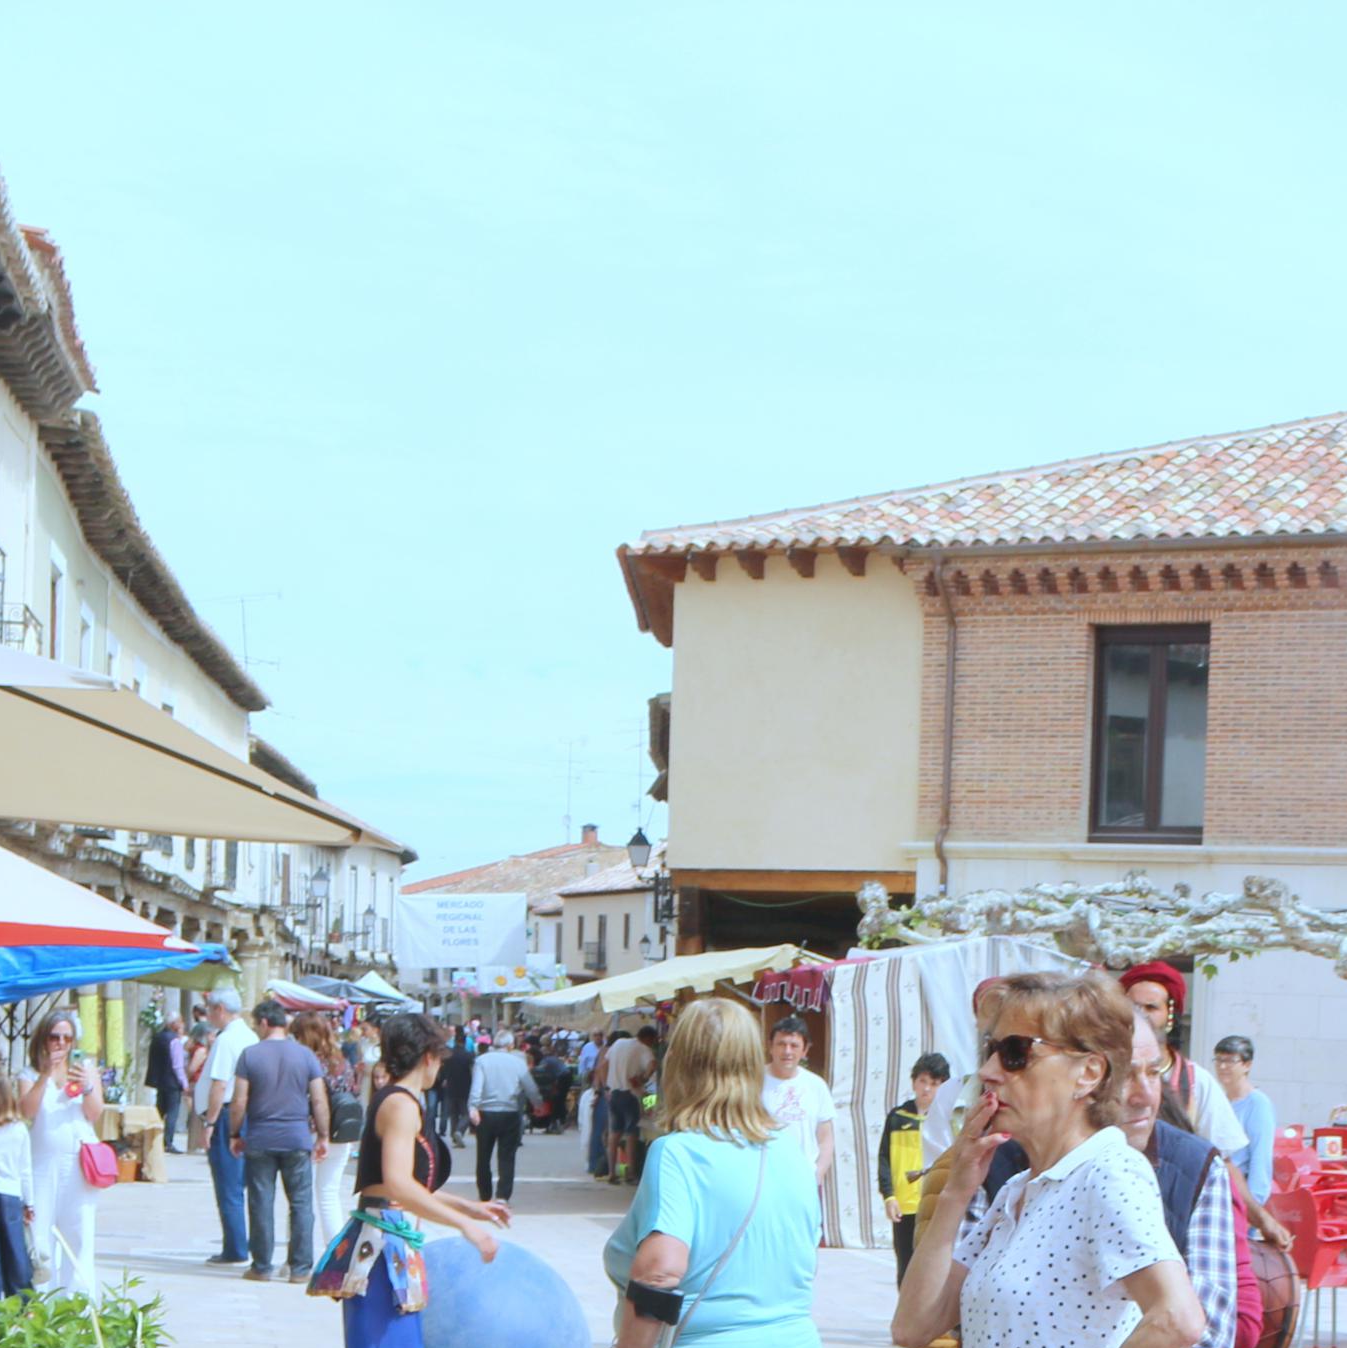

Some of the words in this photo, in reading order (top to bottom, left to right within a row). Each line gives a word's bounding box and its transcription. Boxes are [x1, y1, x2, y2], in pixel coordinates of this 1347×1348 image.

[436, 900, 485, 909] MERCADO
[435, 912, 484, 921] REGIONAL
[443, 925, 455, 934] DE
[457, 925, 477, 934] LAS
[441, 937, 480, 947] FLORES
